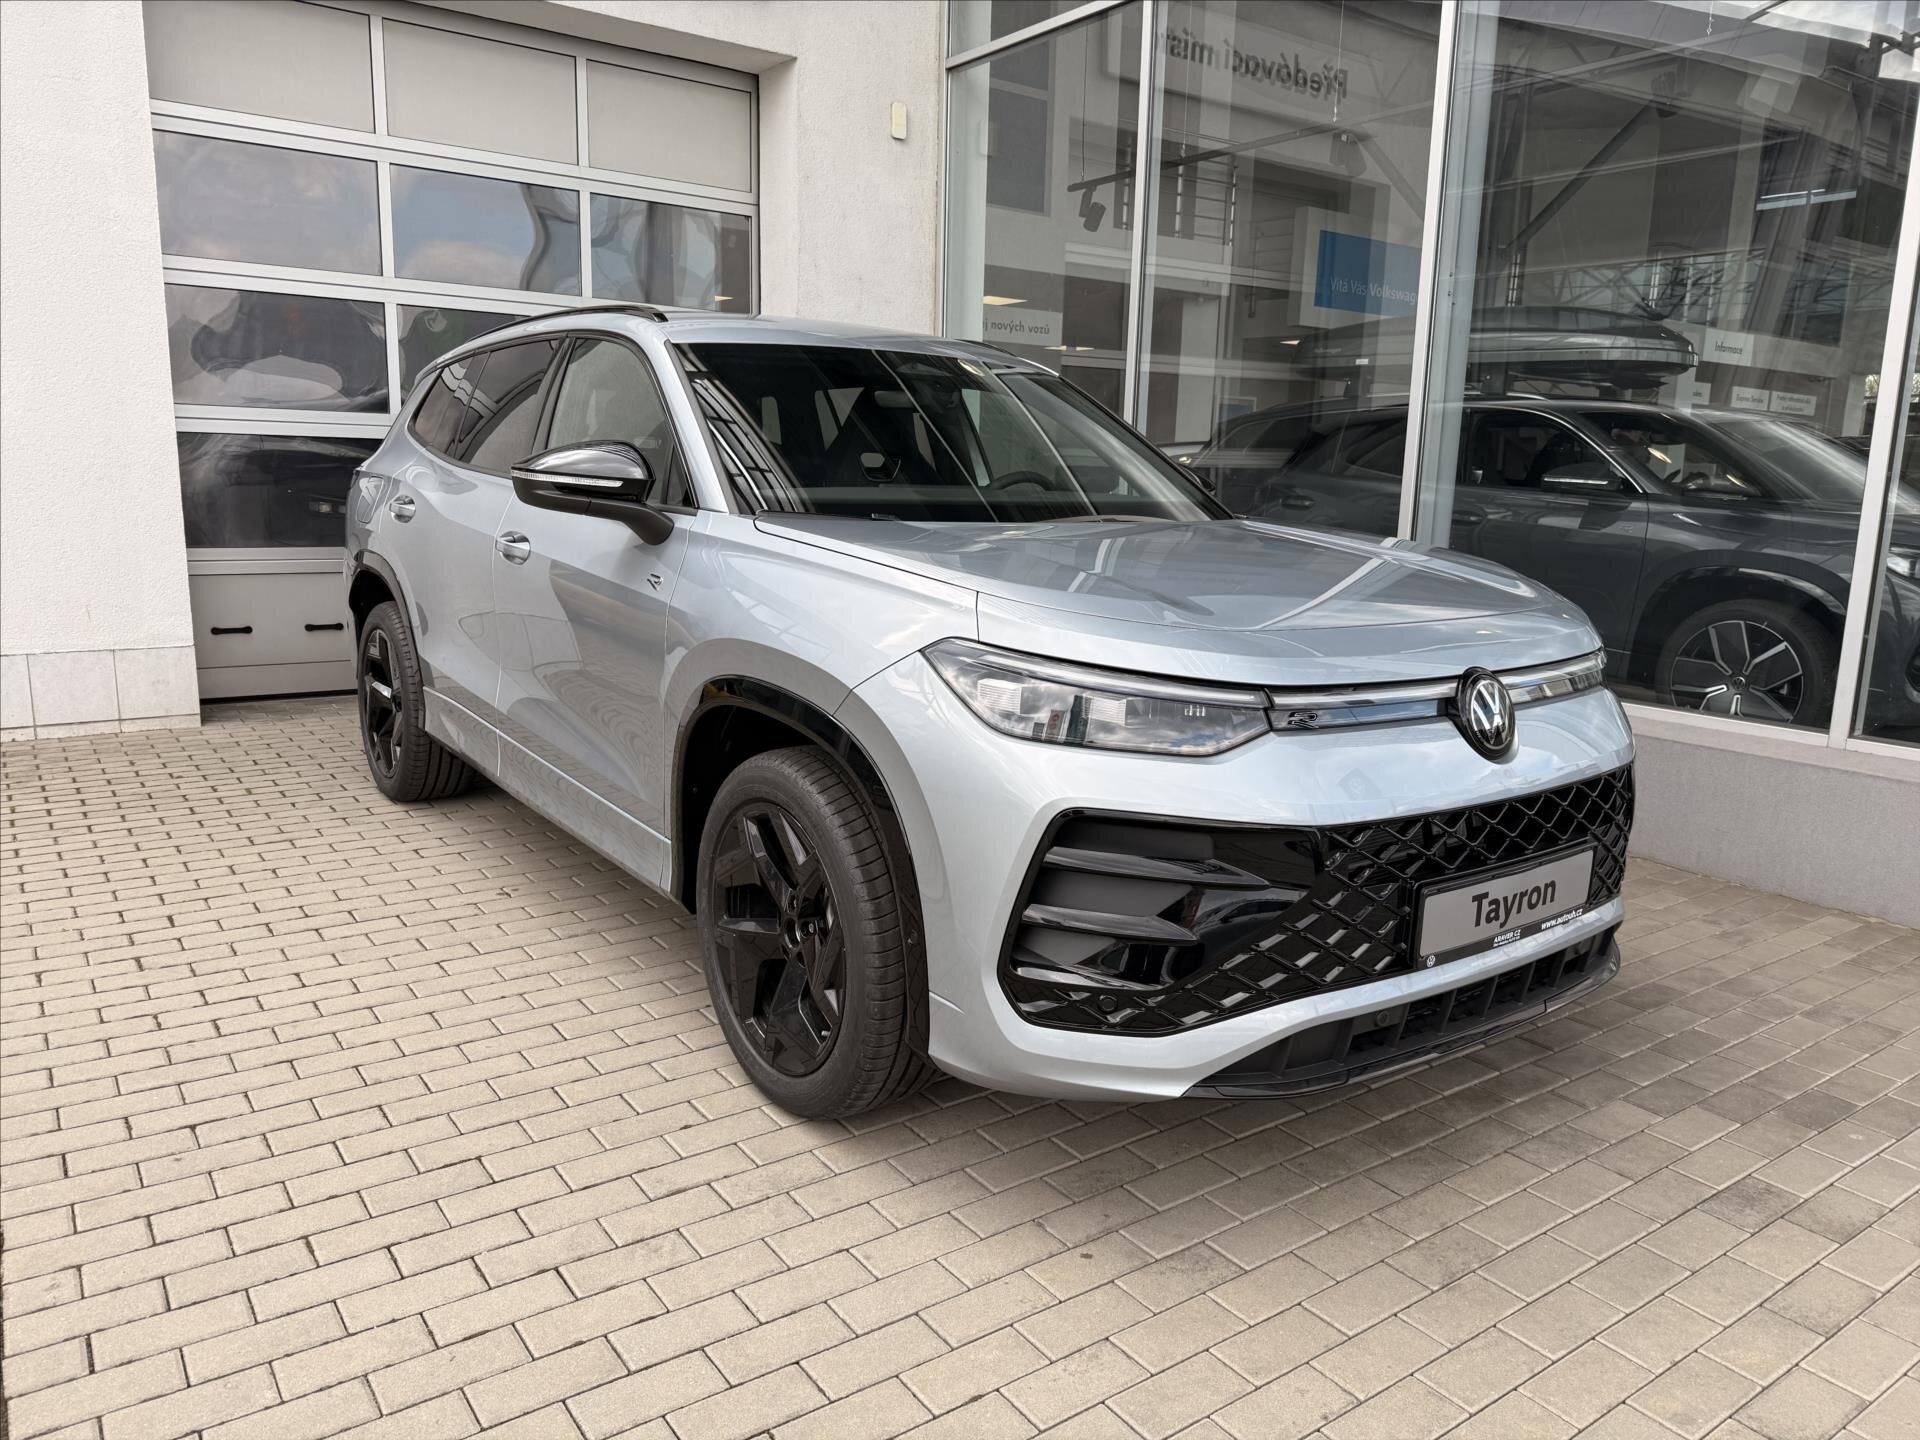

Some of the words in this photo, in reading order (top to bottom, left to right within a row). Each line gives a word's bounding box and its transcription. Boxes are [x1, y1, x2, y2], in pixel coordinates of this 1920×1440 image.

[991, 320, 1025, 334] nových
[1715, 341, 1743, 355] Informace
[1472, 880, 1556, 929] Tayron
